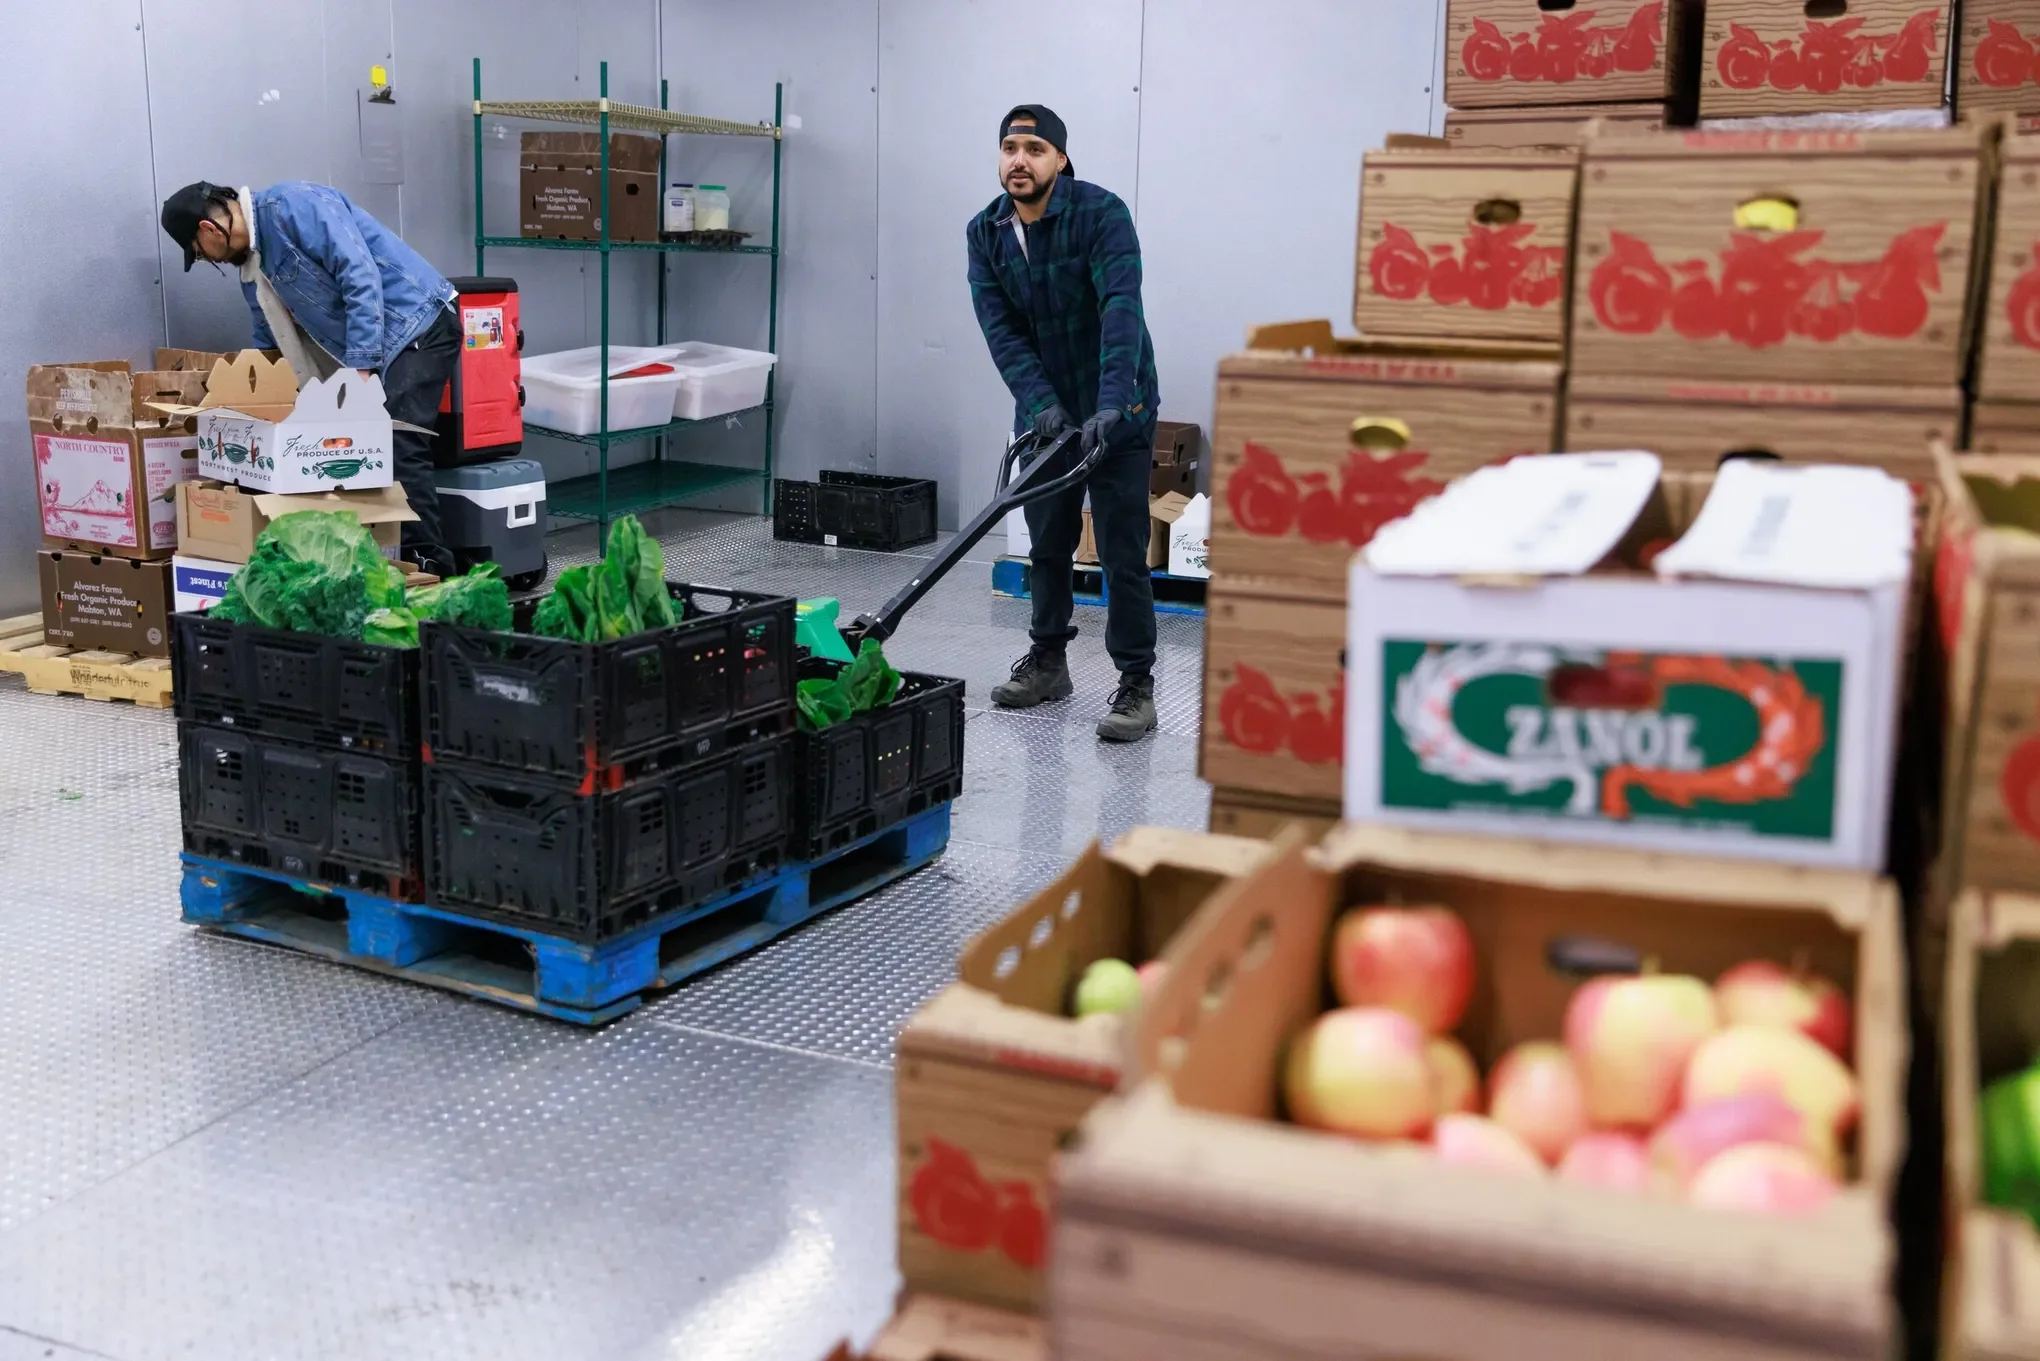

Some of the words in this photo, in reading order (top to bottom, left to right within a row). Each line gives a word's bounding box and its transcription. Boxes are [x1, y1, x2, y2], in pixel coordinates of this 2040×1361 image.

[54, 440, 83, 451] NORTH
[83, 442, 125, 455] COUNTRY
[282, 433, 324, 457] Fresh
[296, 450, 340, 458] PRODUCE
[358, 447, 384, 455] U.S.A.
[200, 460, 238, 473] NORTHWEST
[240, 470, 272, 482] PRODUCE
[73, 581, 100, 592] Alvarez
[101, 584, 123, 594] Farms
[190, 577, 216, 588] Finest
[60, 591, 79, 601] Fresh
[80, 593, 108, 604] Organic
[109, 597, 138, 607] Produce
[107, 607, 122, 616] WA
